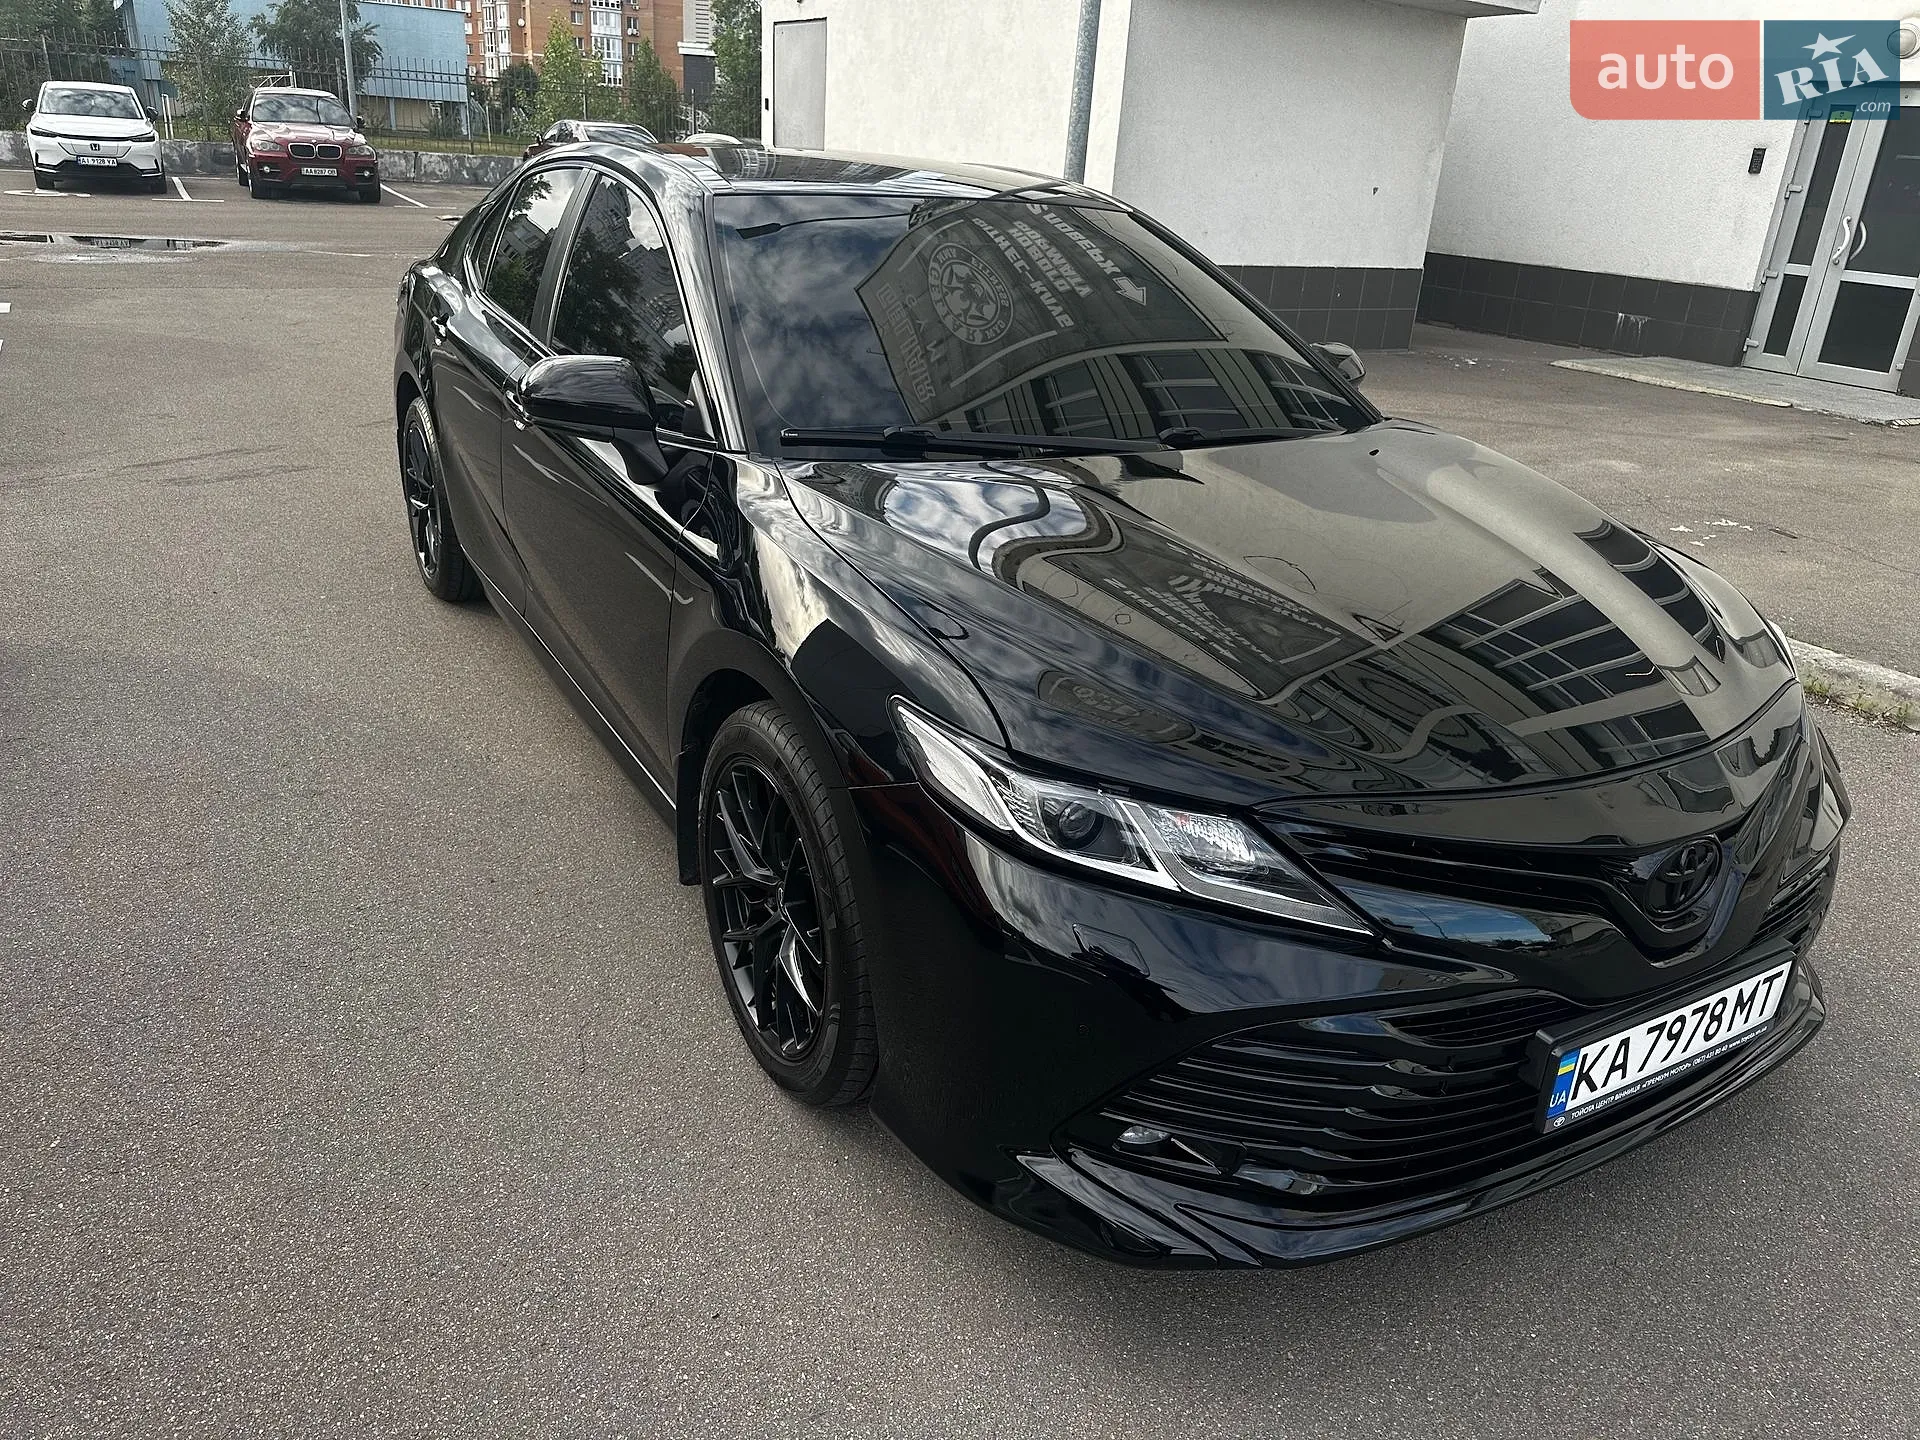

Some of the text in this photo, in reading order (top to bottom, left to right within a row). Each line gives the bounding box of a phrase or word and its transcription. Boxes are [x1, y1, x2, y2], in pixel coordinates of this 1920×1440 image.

[1571, 969, 1784, 1101] KA 7978 MT
[1549, 1089, 1568, 1109] UA
